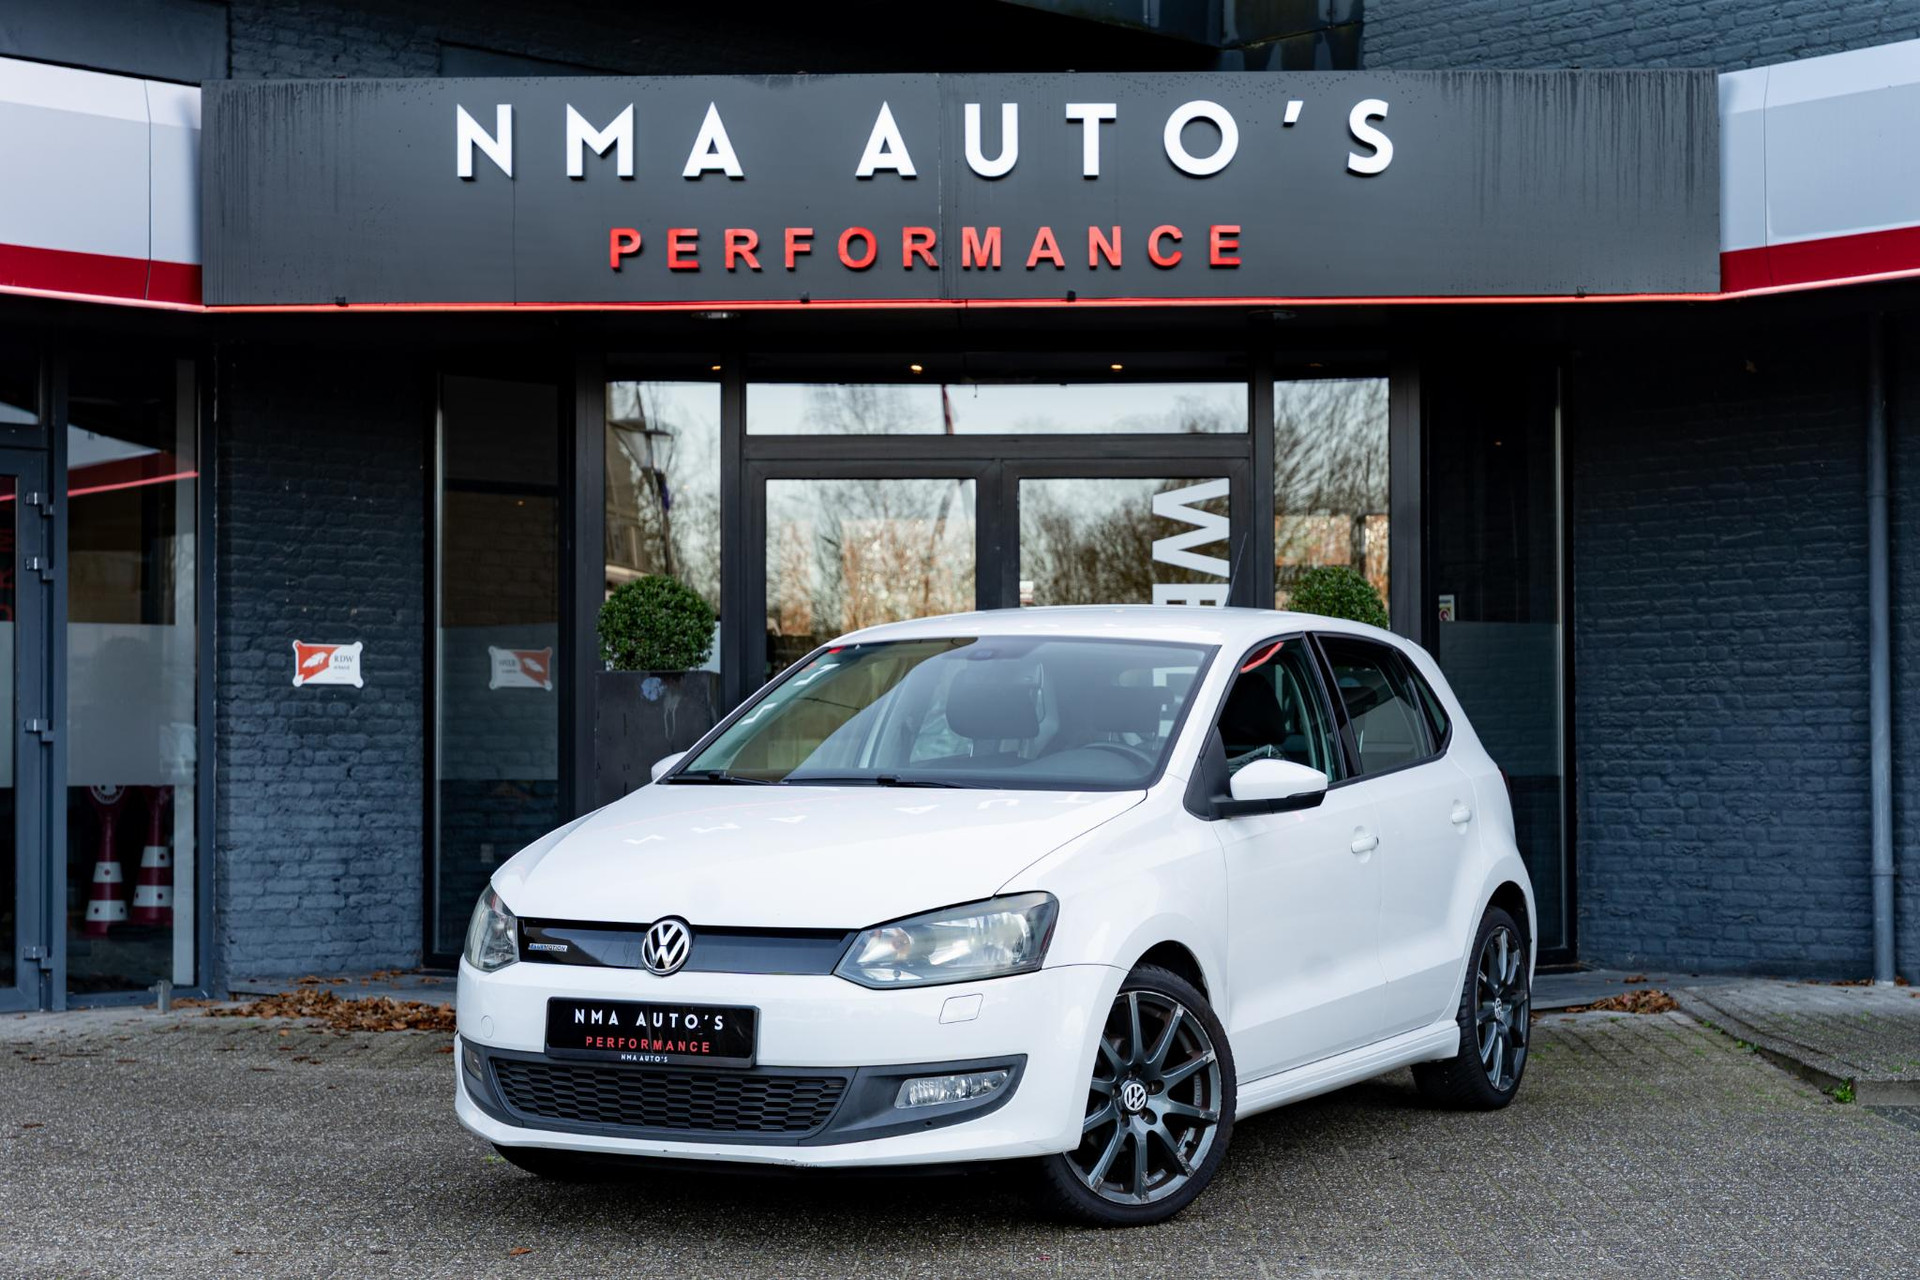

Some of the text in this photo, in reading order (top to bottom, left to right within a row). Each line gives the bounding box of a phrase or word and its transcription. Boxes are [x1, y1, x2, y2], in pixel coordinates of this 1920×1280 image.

[456, 98, 1394, 178] NMA AUTO'S
[609, 224, 1242, 270] PERFORMANCE
[574, 1008, 724, 1031] NMA AUTO'S
[585, 1036, 710, 1053] PERFORMANCE
[620, 1053, 668, 1063] NMA AUTO'S
